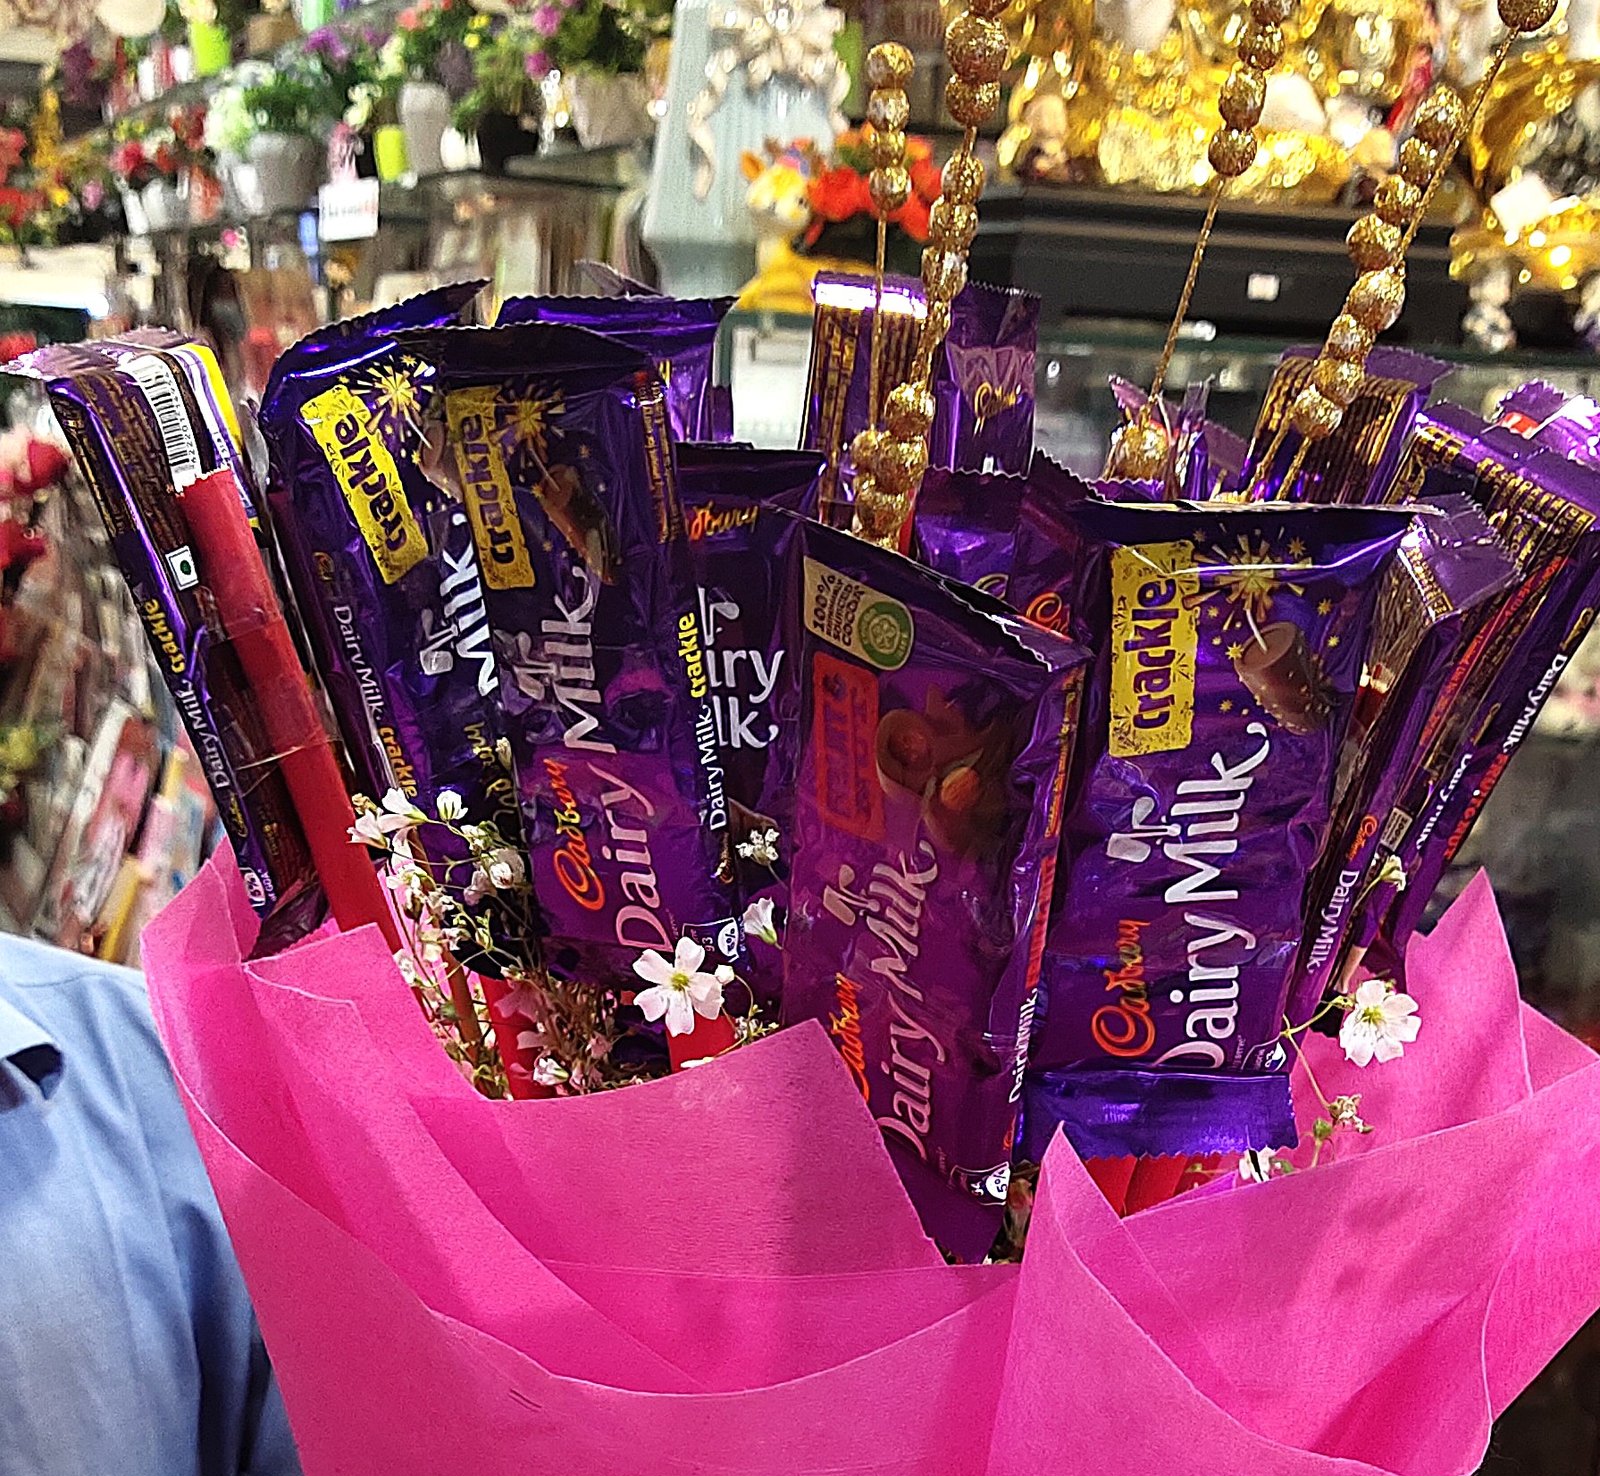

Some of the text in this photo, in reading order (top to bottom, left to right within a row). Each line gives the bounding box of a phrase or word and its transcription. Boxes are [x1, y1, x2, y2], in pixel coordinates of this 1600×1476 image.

[335, 413, 407, 552] crackle
[461, 414, 515, 564] crackle
[142, 598, 186, 674] crackle
[440, 512, 498, 696] Milk
[813, 575, 837, 633] 100%
[678, 611, 708, 698] crackle
[705, 649, 785, 704] iry
[1122, 578, 1179, 729] crackle
[1528, 652, 1568, 707] Dairy
[174, 678, 230, 788] Dairy Milk
[377, 727, 419, 799] crackle
[542, 566, 674, 954] Dairy Milk
[696, 704, 718, 765] Milk
[712, 694, 779, 748] lk
[1502, 702, 1538, 753] Milk
[543, 757, 606, 912] Cadbury
[706, 767, 727, 831] Dairy
[1163, 722, 1270, 903] Milk
[866, 840, 938, 1002] Milk
[1306, 870, 1360, 974] Dairy Milk
[1091, 919, 1156, 1058] Cadbury
[989, 1169, 1007, 1193] 5%
